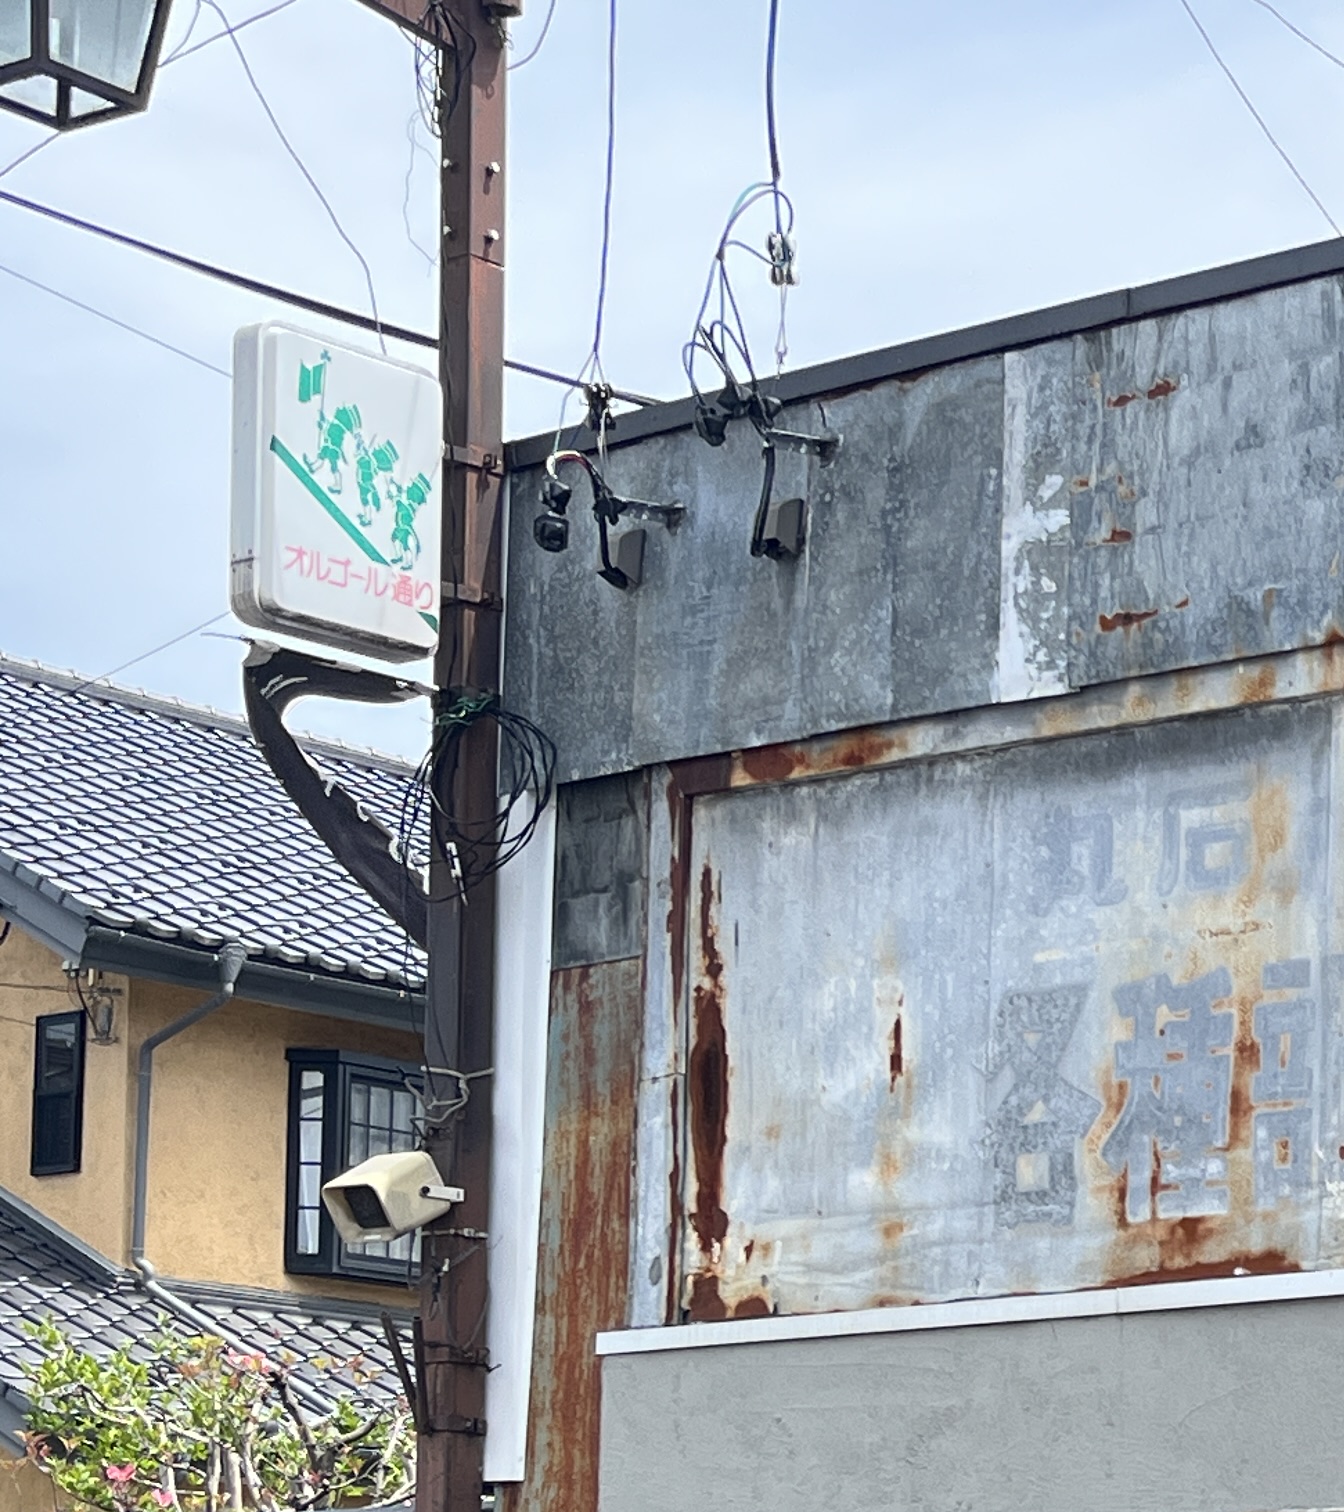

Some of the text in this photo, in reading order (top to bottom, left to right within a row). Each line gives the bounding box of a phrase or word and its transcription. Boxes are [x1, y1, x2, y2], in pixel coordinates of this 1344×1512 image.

[284, 546, 434, 610] オルゴール通り
